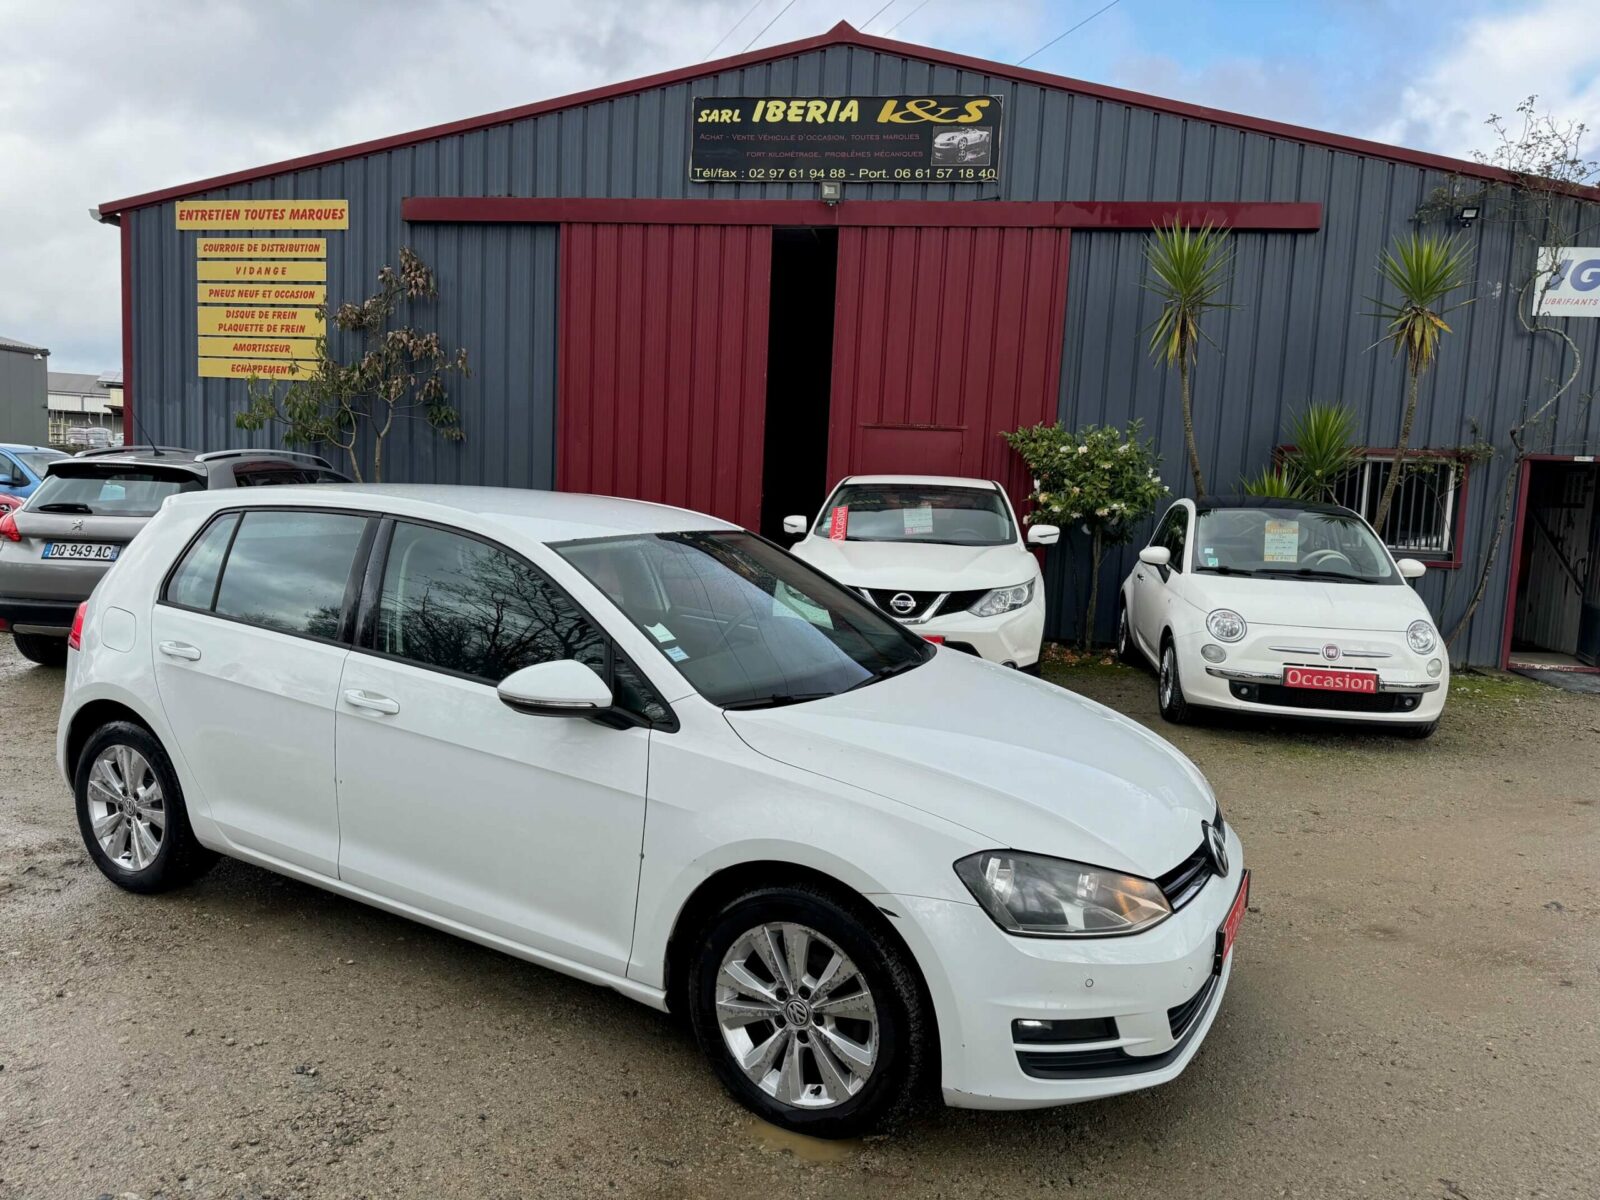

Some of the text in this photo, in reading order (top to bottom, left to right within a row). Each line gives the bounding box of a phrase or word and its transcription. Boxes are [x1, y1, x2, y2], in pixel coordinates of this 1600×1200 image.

[697, 109, 742, 124] SARL
[751, 99, 859, 125] IBERIA
[693, 167, 738, 179] Tél/fax
[748, 168, 765, 178] 02
[768, 168, 785, 178] 97
[788, 168, 804, 178] 61
[809, 168, 825, 178] 94
[829, 168, 846, 178] 88
[858, 168, 890, 179] Port.
[894, 168, 911, 179] 06
[914, 168, 931, 179] 61
[935, 168, 953, 179] 57
[958, 168, 974, 179] 18
[977, 168, 996, 179] 40
[178, 208, 346, 221] ENTRETIEN TOUTES MARQUES
[203, 243, 321, 253] COURROIE DE DISTRIBUTION
[235, 266, 288, 276] VIDANGE
[208, 289, 316, 299] PNEUS NEUF ET OCCASION
[225, 310, 298, 320] DISQUE DE FREIN
[217, 323, 306, 334] PLAQUETTE DE FREIN
[232, 343, 291, 354] AMORTISSEUR
[50, 544, 112, 558] DQ-949-AC
[1286, 669, 1376, 691] Occasion
